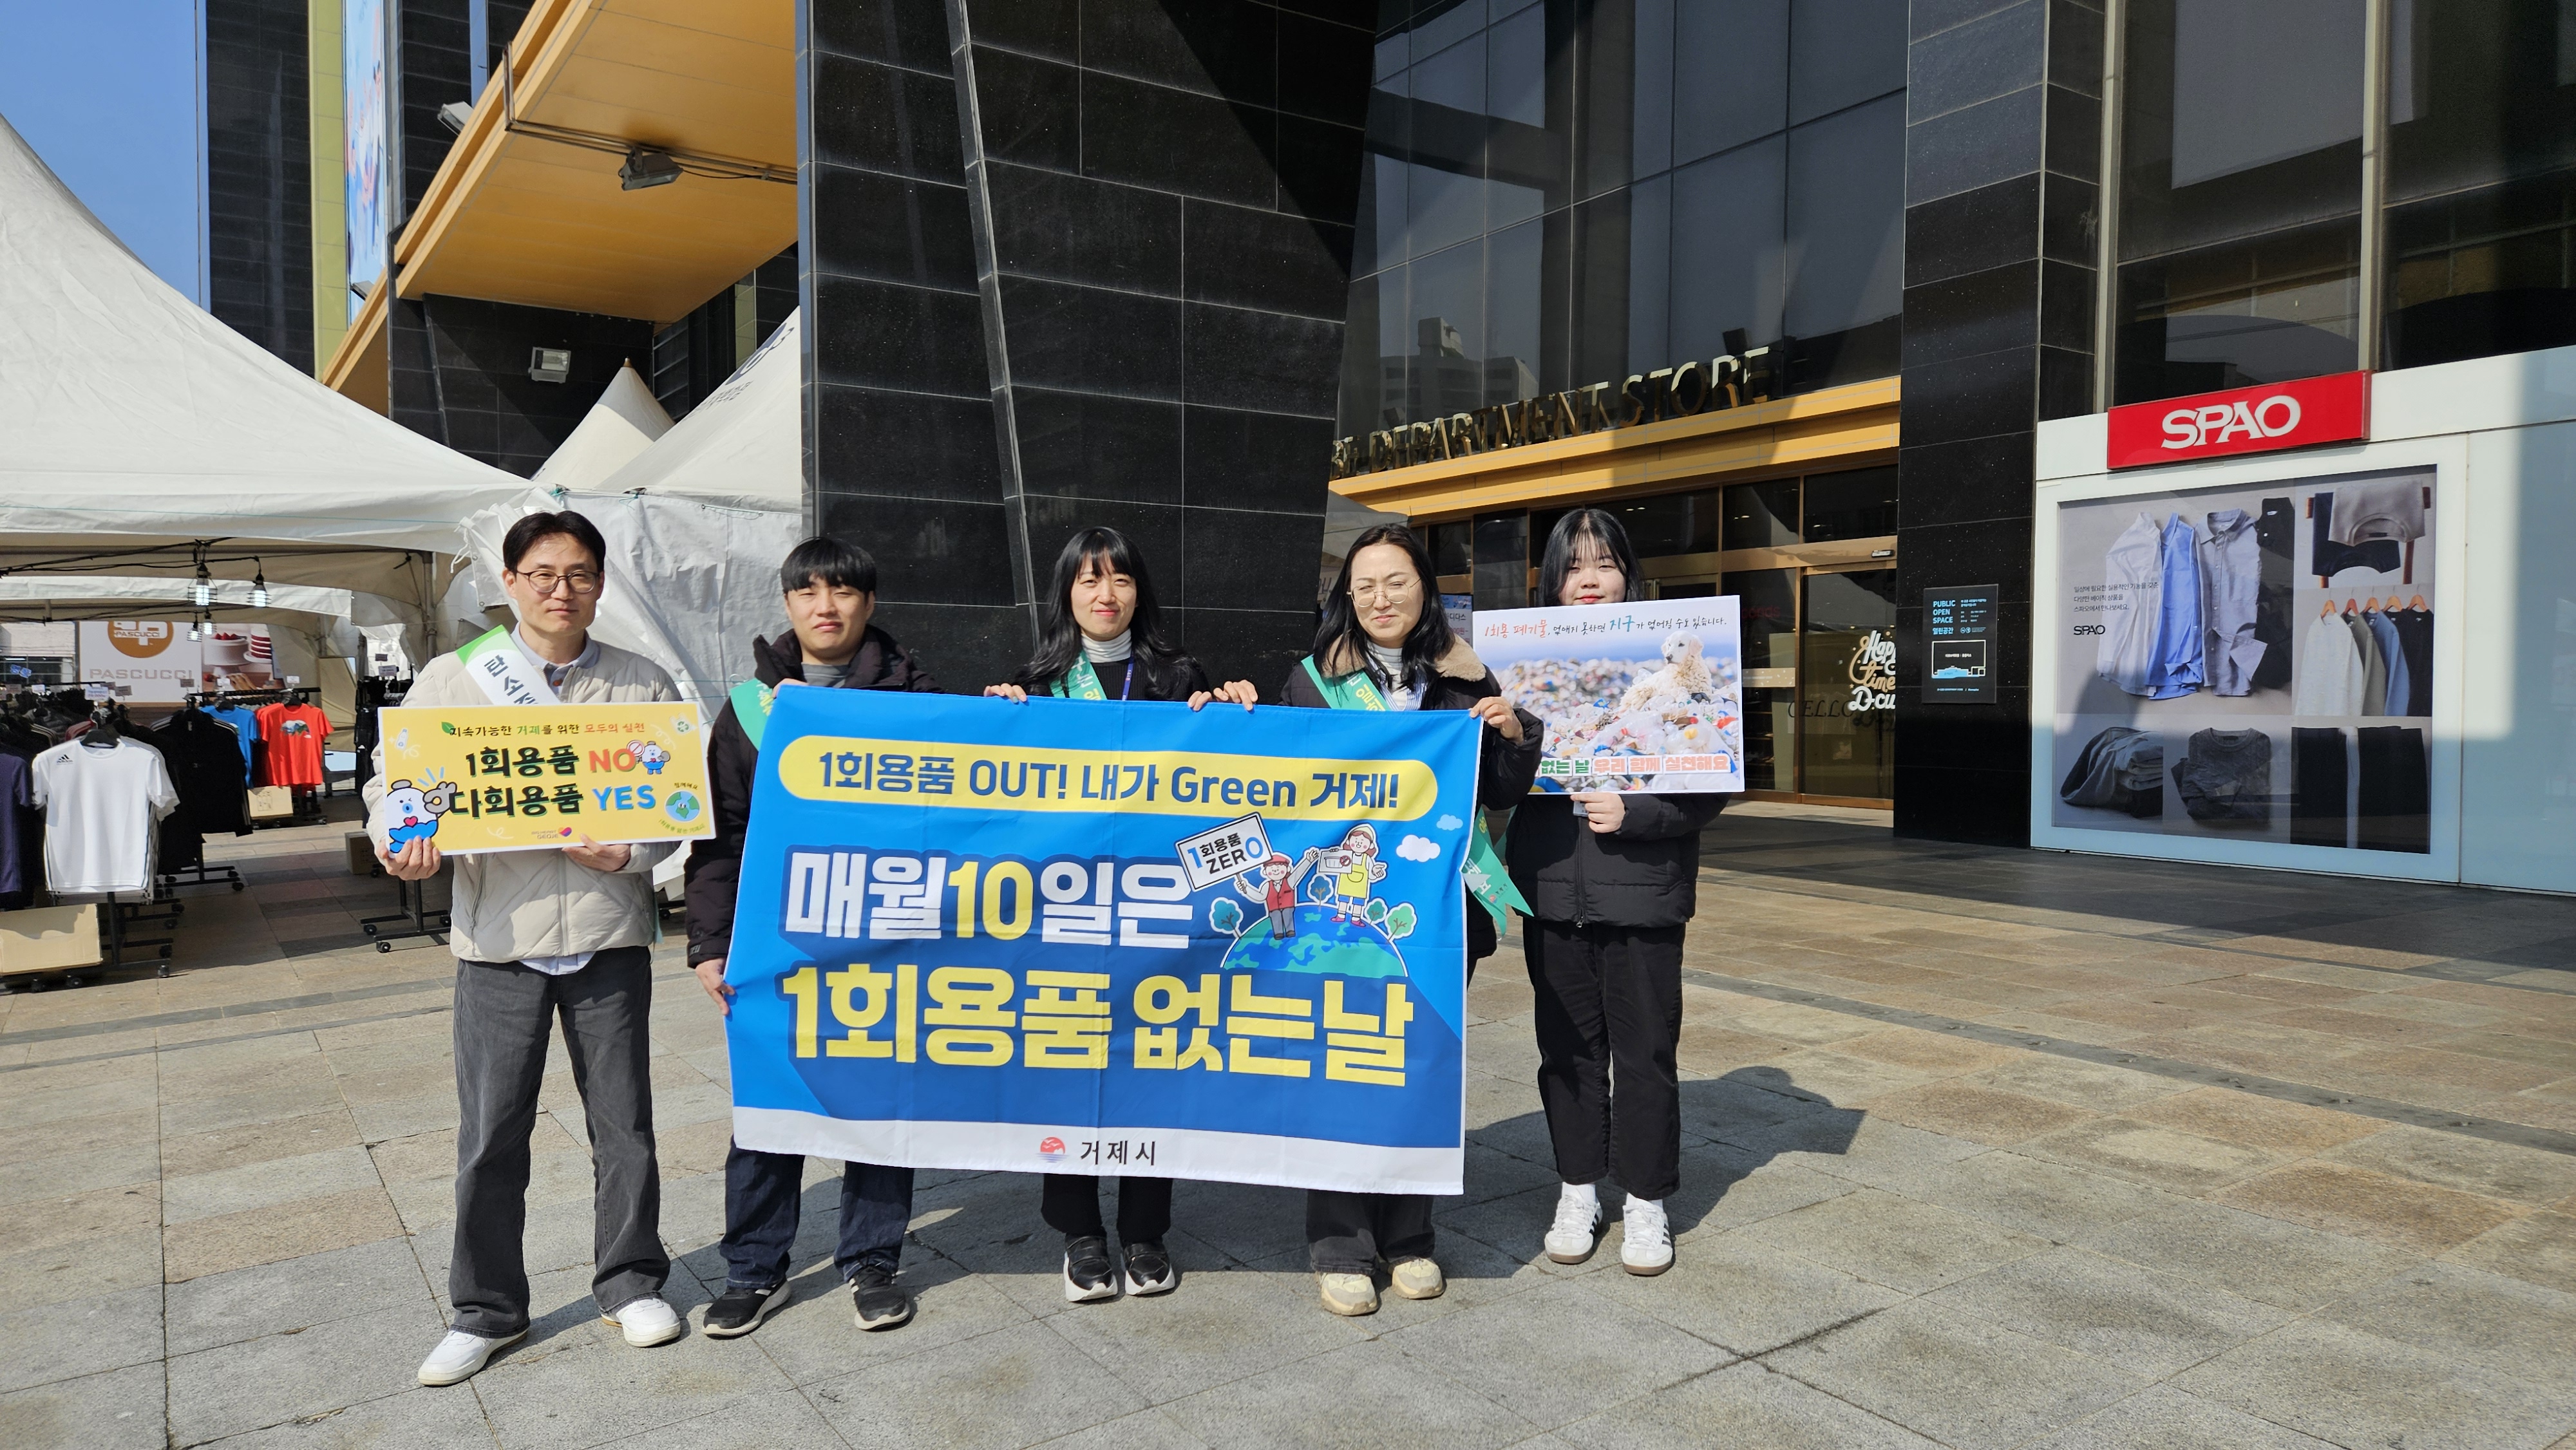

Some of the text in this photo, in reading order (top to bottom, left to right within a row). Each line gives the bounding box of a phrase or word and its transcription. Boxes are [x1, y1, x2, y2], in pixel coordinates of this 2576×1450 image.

[1369, 381, 1611, 474] DEPARTMENT
[1619, 346, 1768, 428] STORE
[2161, 395, 2301, 449] SPAO
[2073, 625, 2106, 636] SPAO
[90, 669, 193, 679] PASCUCCI
[450, 722, 645, 737] 지속가능한 거제를 위한 모두의 실천
[465, 744, 637, 778] 1회용품 NO
[1541, 755, 1728, 774] 없는 날 우리 함께 실천해요
[819, 751, 1399, 810] 1회용품 OUT! 내가 Green 거제!
[450, 783, 656, 819] 다회용품 YES
[1187, 833, 1242, 869] 1회용품
[782, 963, 1112, 1070] 1회용품
[1080, 1140, 1156, 1166] 거제시
